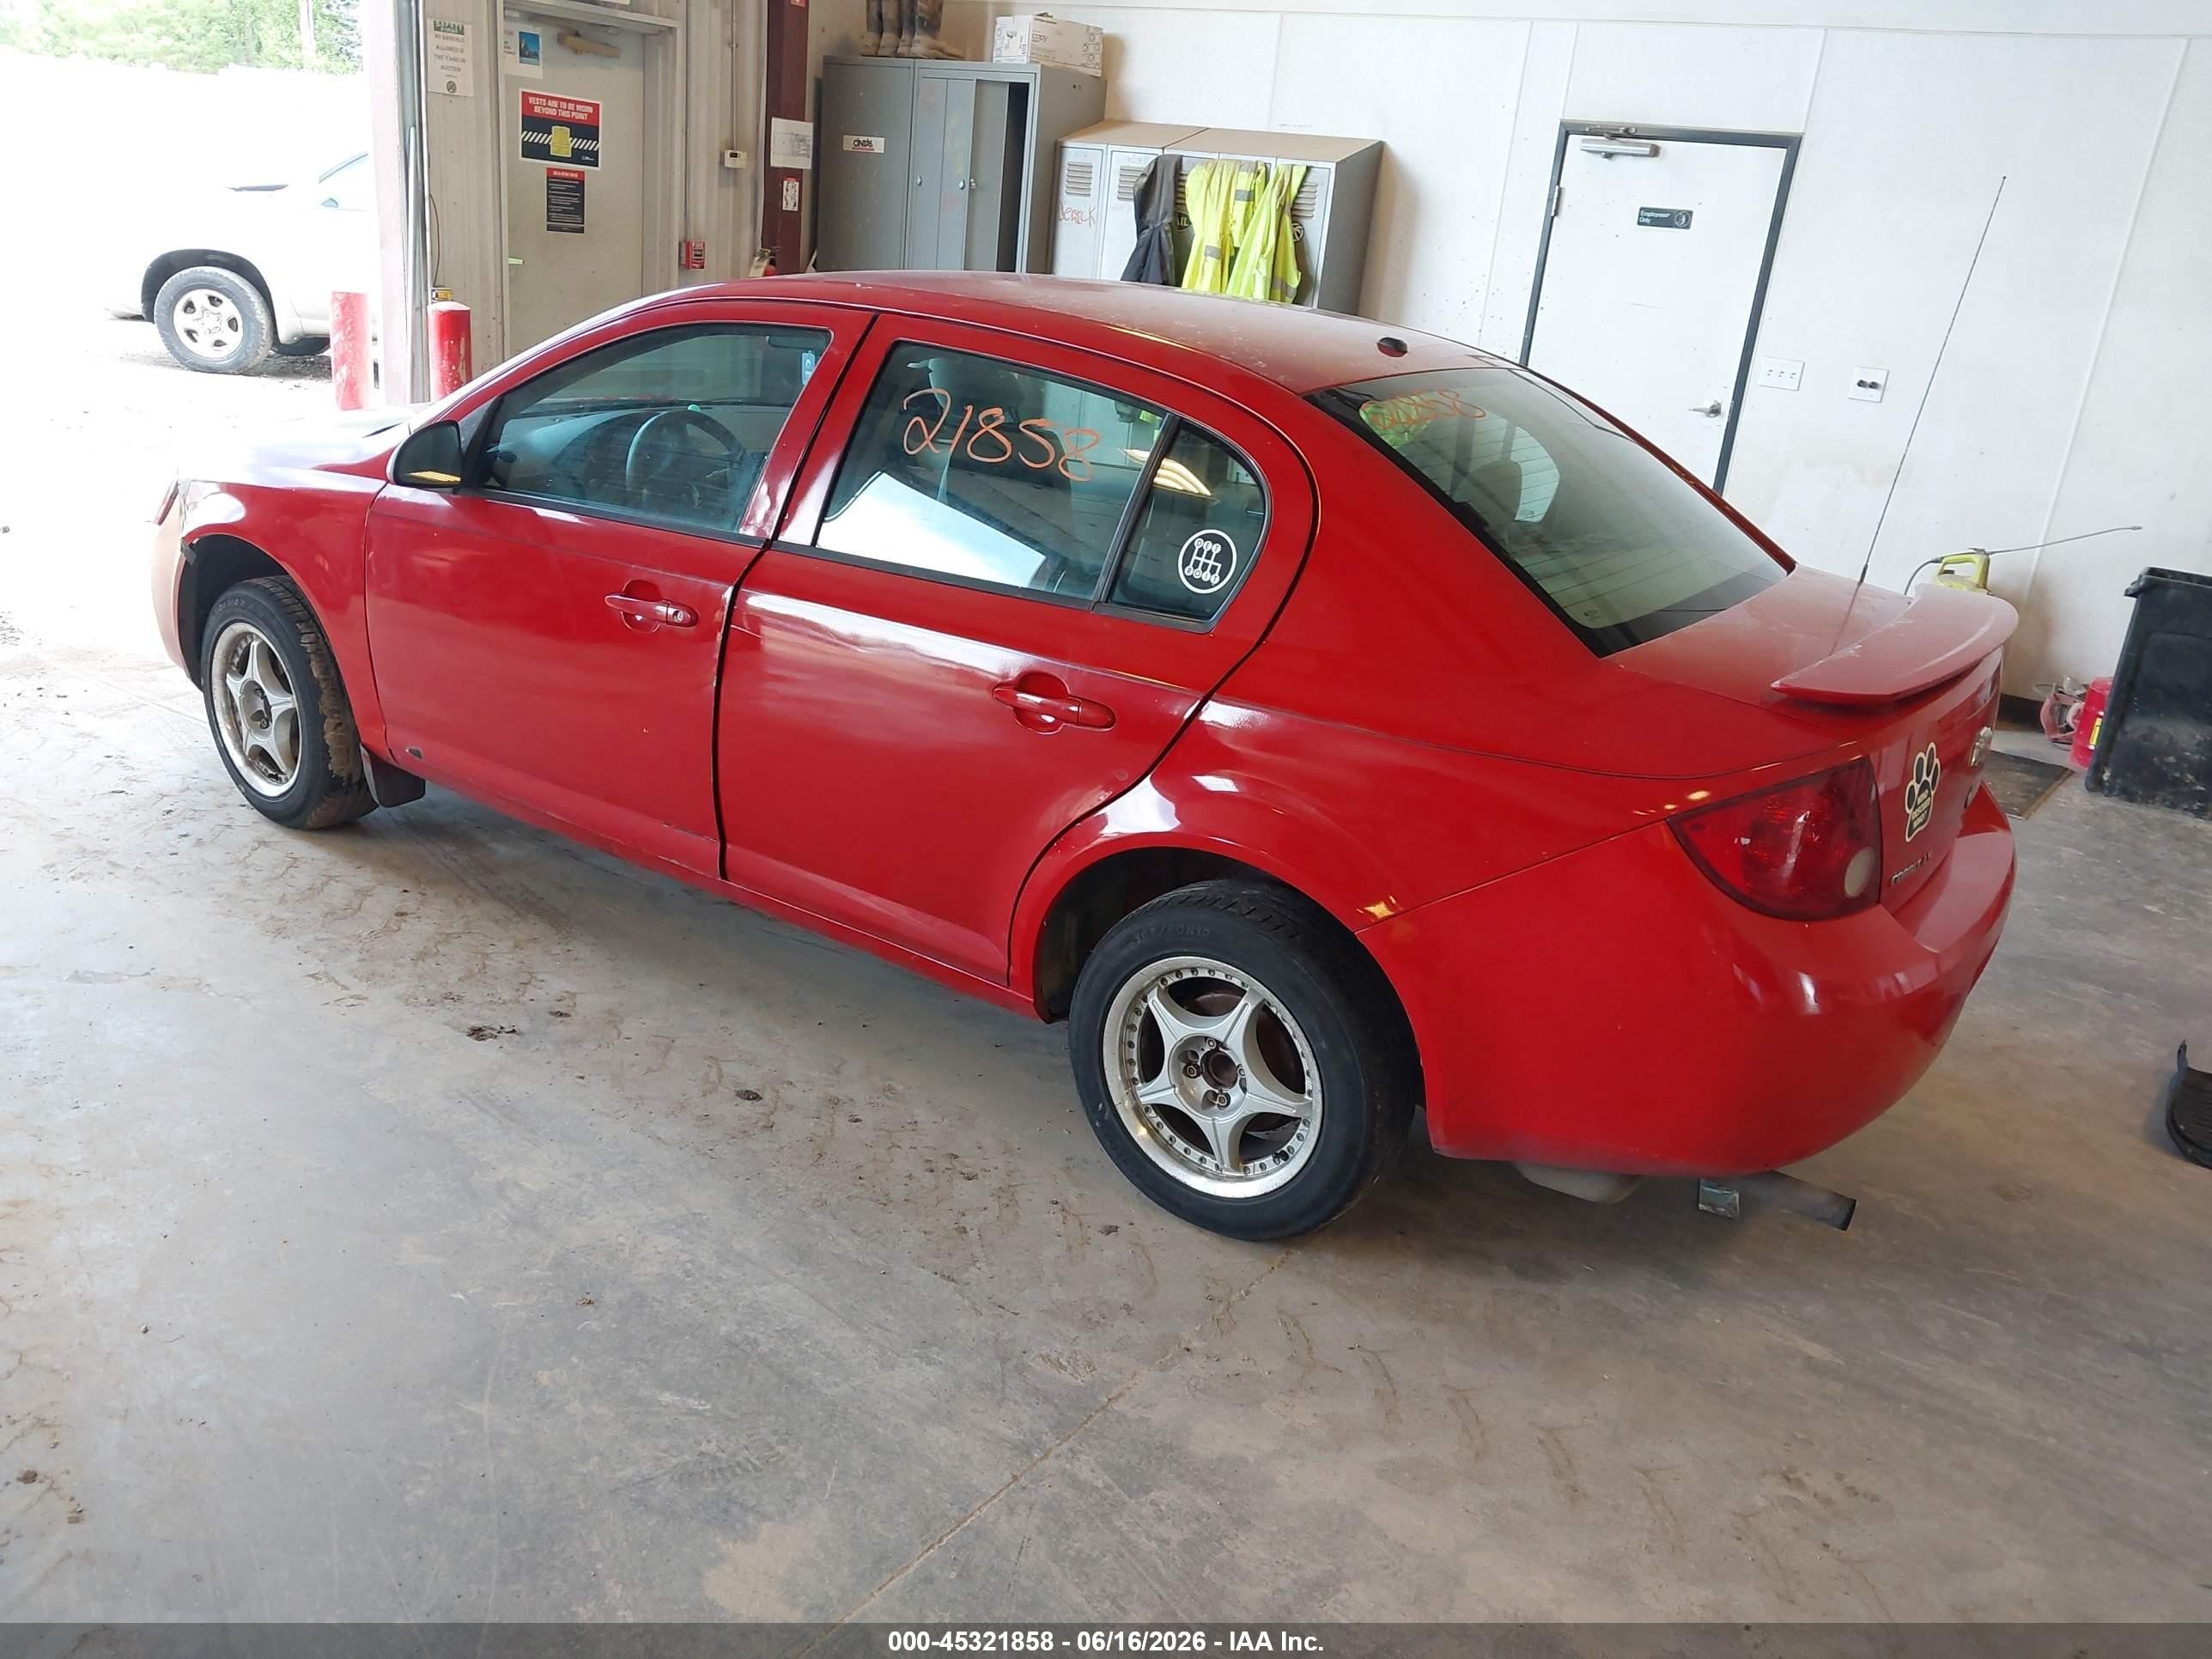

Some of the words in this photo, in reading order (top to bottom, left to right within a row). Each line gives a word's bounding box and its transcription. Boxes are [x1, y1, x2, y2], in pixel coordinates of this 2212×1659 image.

[528, 96, 547, 106] VESTS
[548, 100, 558, 108] ARE
[534, 105, 557, 116] BEYOND
[558, 109, 570, 118] THIS
[571, 111, 588, 120] POINT
[903, 388, 1100, 482] 21858
